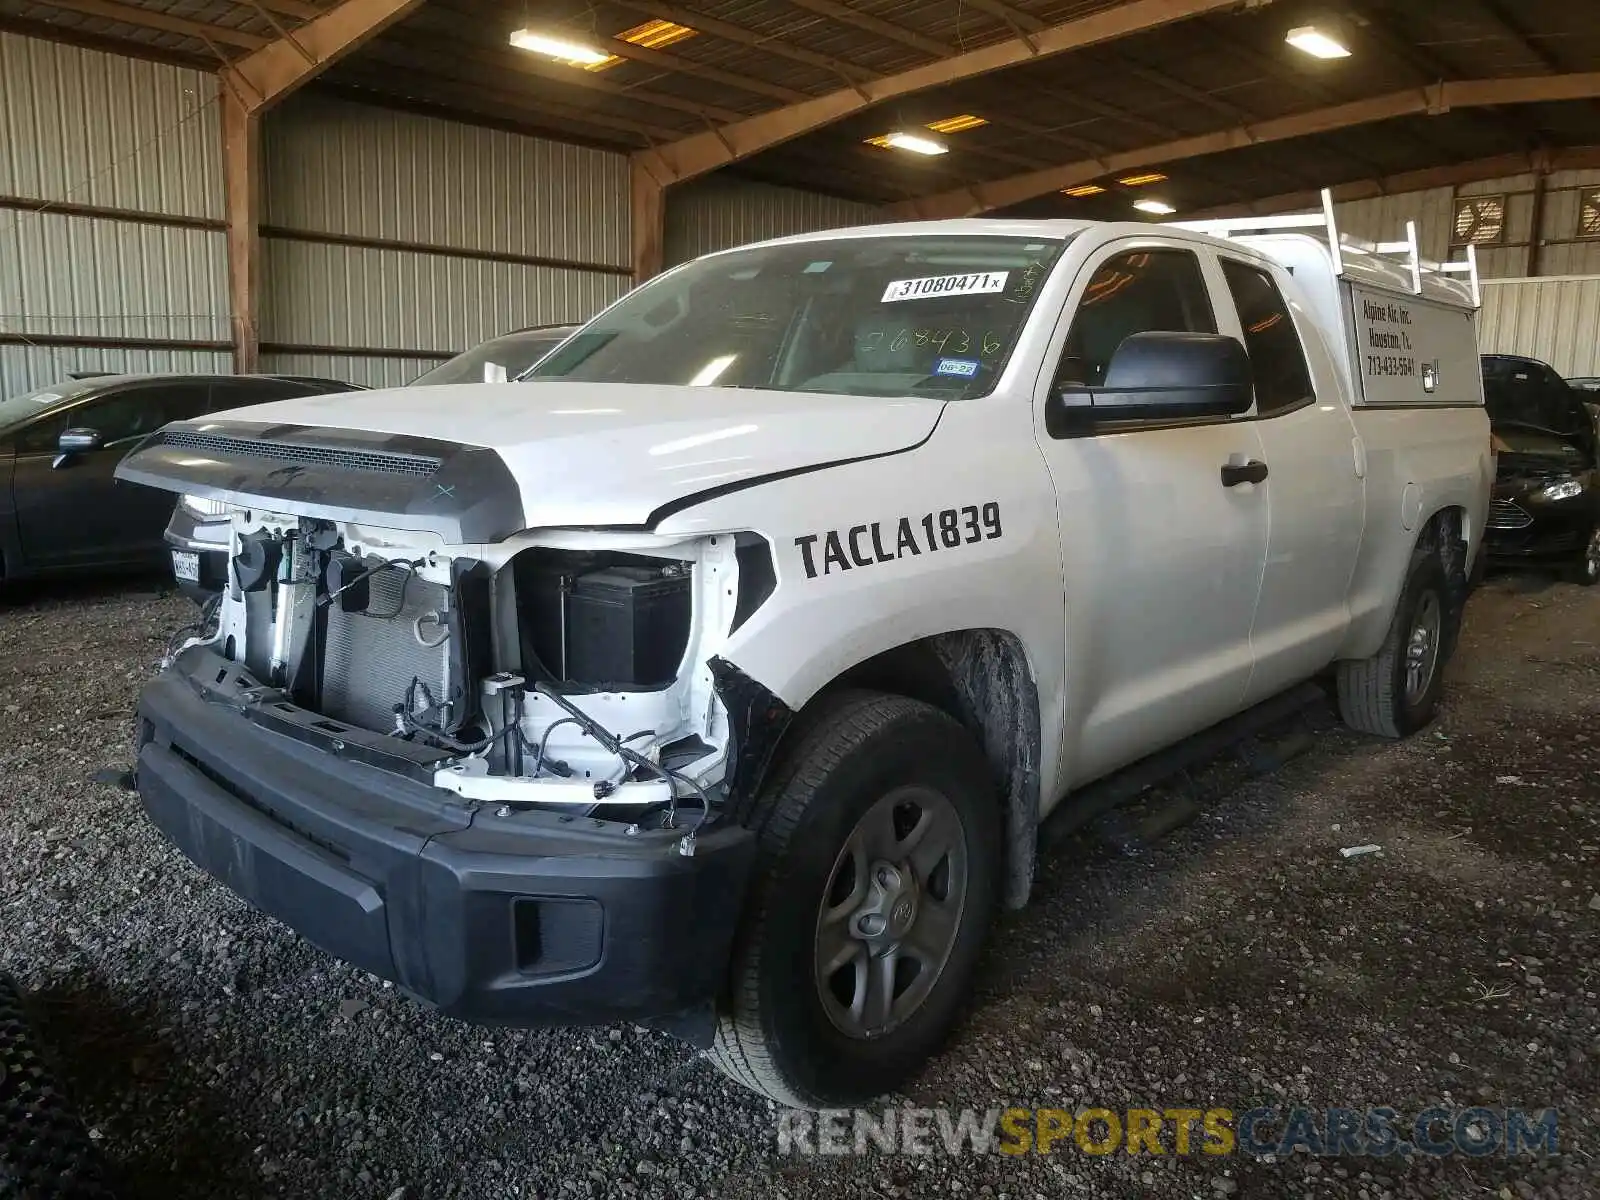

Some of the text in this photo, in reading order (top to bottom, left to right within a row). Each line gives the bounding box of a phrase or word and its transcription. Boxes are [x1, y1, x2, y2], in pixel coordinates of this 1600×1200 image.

[900, 274, 990, 296] 31080471
[1363, 299, 1386, 324] Alpine
[794, 501, 1003, 579] TACLA1839
